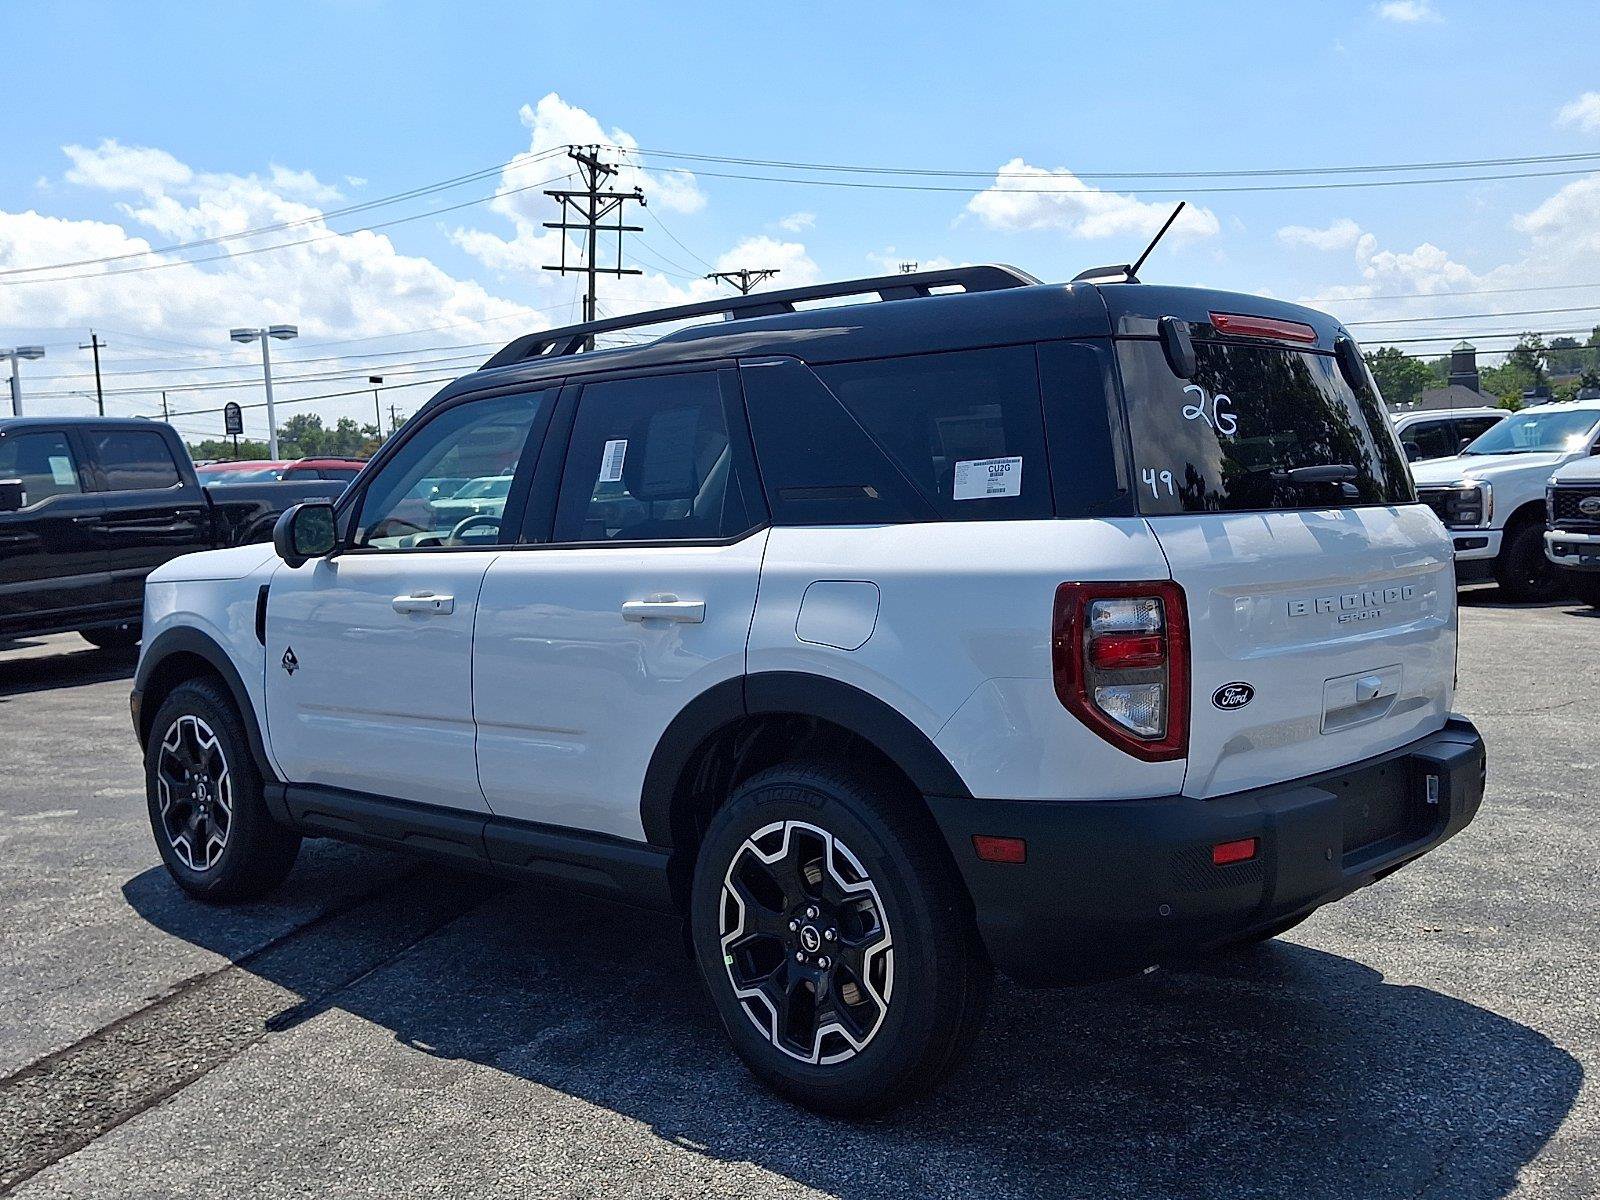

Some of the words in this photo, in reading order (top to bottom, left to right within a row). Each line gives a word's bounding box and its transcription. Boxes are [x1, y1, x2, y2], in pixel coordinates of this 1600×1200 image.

[1182, 384, 1238, 435] 2G
[988, 463, 1011, 473] CU2G
[1142, 468, 1174, 499] 49
[1287, 584, 1416, 617] BRONCO
[1337, 608, 1386, 624] SPORT
[1221, 687, 1249, 705] Ford
